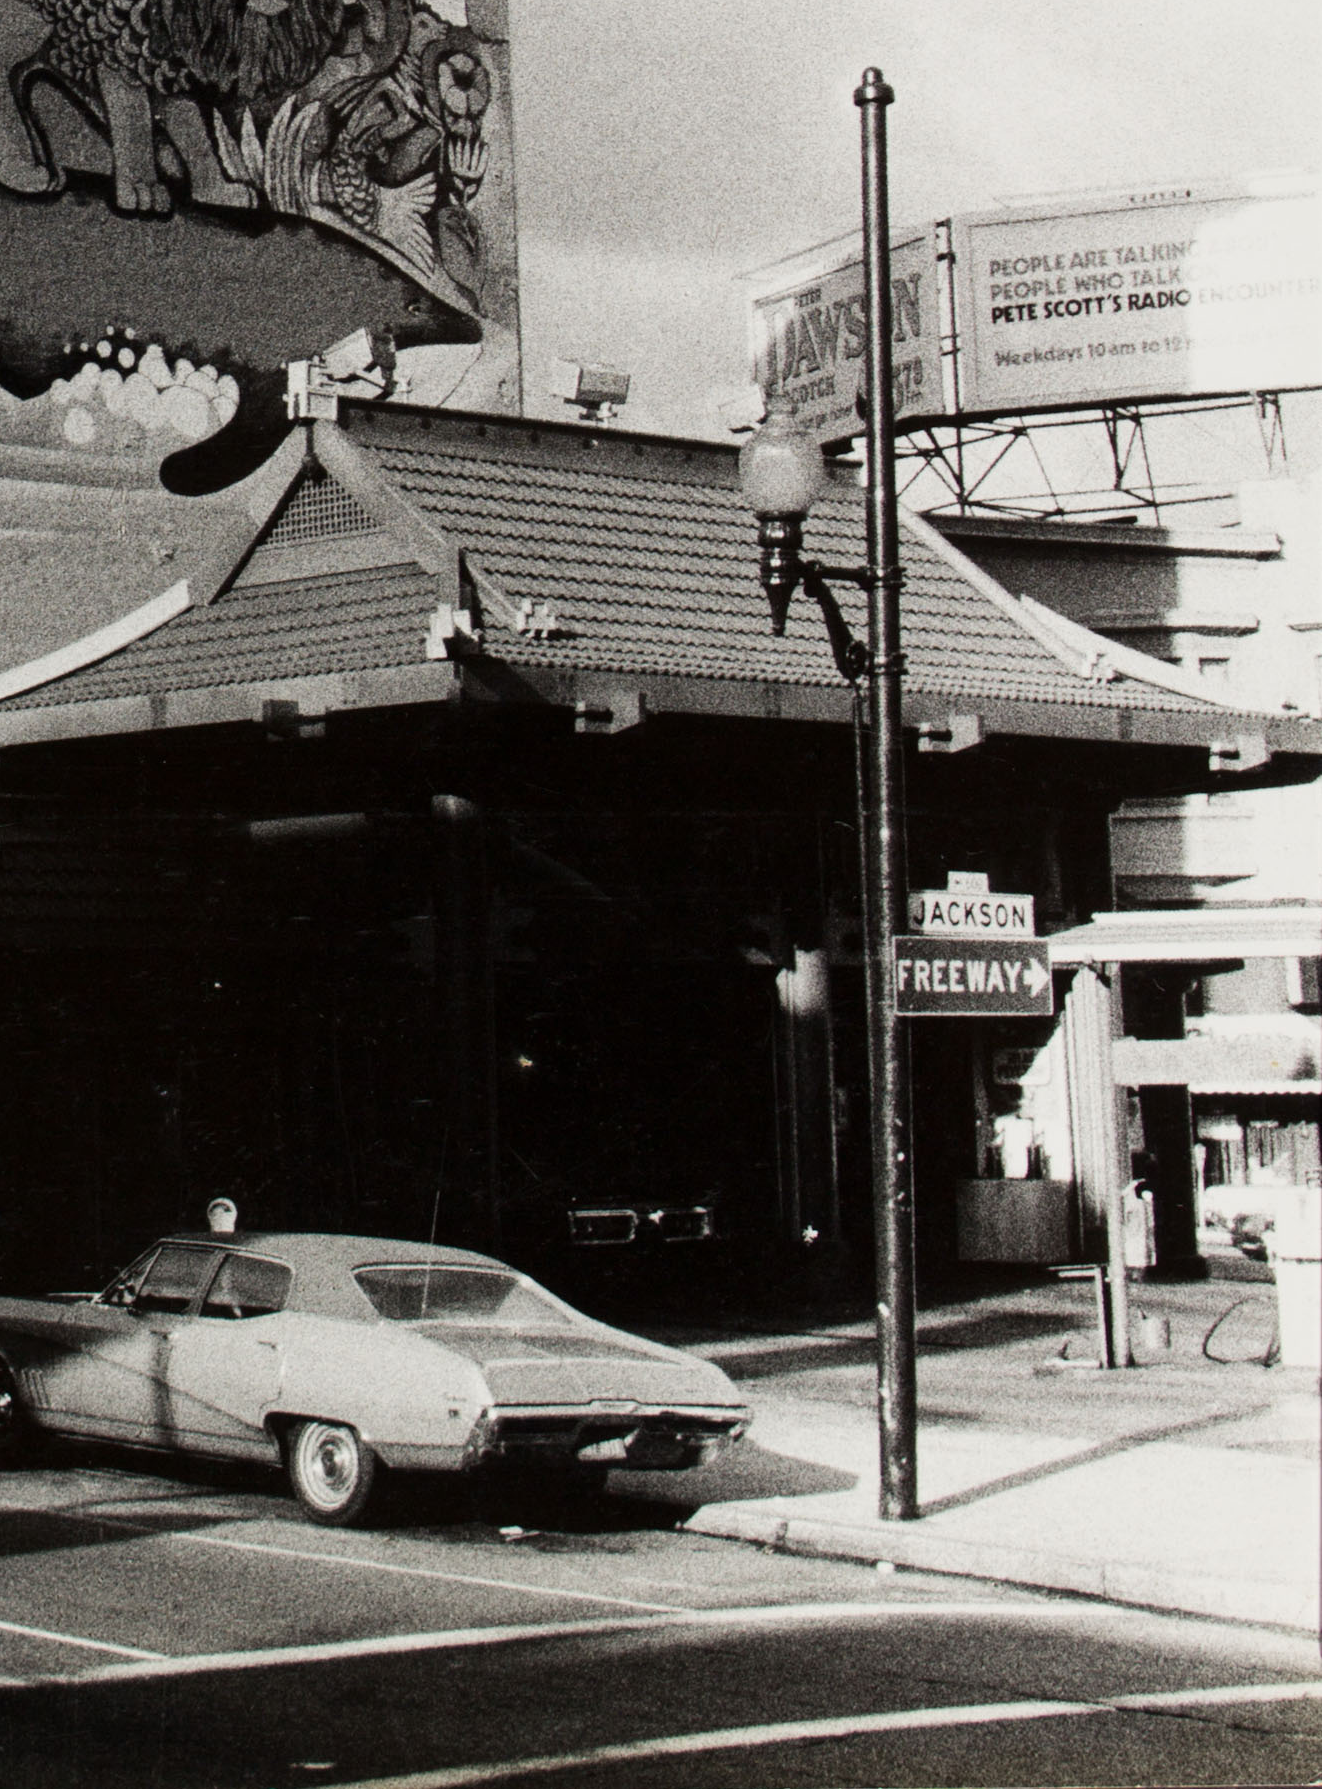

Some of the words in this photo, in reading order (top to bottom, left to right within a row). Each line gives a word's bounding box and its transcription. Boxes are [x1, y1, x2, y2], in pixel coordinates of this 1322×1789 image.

[990, 254, 1066, 277] PEOPLE
[1070, 250, 1109, 269] ARE
[990, 277, 1067, 301] PEOPLE
[1074, 272, 1123, 293] WHO
[1131, 266, 1182, 287] TALK
[991, 303, 1037, 324] PETE
[1043, 294, 1121, 319] SCOTT'S
[1128, 289, 1192, 311] RADIO
[764, 272, 923, 395] DAWSN
[994, 345, 1083, 367] Weekdays
[1087, 342, 1106, 358] 10
[1109, 342, 1136, 357] am
[1141, 339, 1160, 354] to
[913, 900, 1026, 928] JACKSON
[897, 958, 1022, 994] FREEWAY
